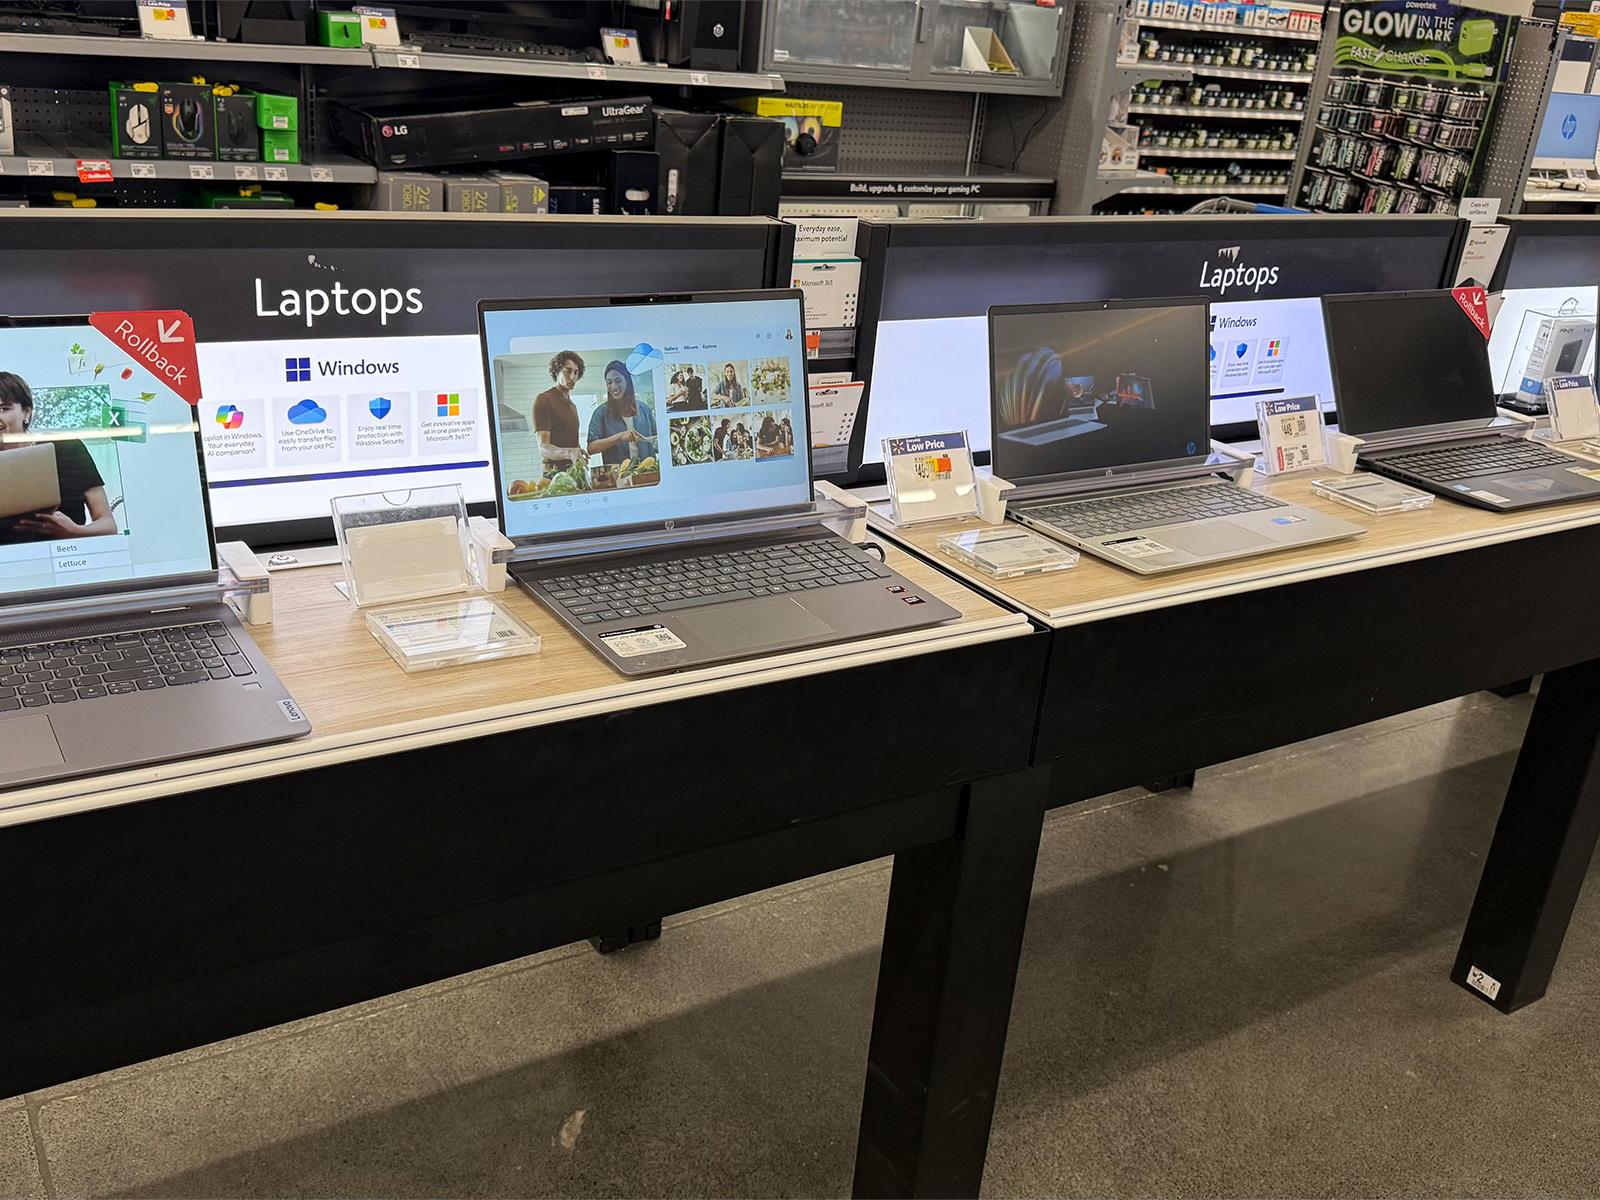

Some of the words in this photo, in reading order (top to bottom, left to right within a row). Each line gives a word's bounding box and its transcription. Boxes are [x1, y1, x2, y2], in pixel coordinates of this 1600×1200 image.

[1405, 1, 1438, 10] powertek
[1343, 8, 1418, 38] GLOW
[1418, 15, 1431, 28] IN
[1434, 16, 1455, 30] THE
[1416, 28, 1452, 42] DARK
[1350, 46, 1374, 60] FAST
[1386, 49, 1430, 66] CHARGE
[602, 104, 646, 118] UltraGear
[394, 126, 408, 135] LG
[850, 184, 868, 192] Build,
[869, 184, 896, 194] upgrade,
[904, 184, 933, 192] customize
[934, 186, 947, 194] your
[948, 186, 970, 194] gaming
[970, 185, 980, 193] PC
[798, 224, 826, 234] Everyday
[821, 234, 848, 244] potential
[1200, 260, 1280, 295] Laptops
[255, 278, 424, 328] Laptops
[1459, 292, 1486, 329] Rollback
[1218, 316, 1258, 329] Windows
[114, 319, 188, 386] Rollback
[318, 359, 400, 377] Windows
[1274, 405, 1286, 414] Low
[1286, 403, 1300, 412] Price
[294, 428, 326, 436] OneDrive
[358, 425, 375, 433] Enjoy
[204, 434, 222, 442] opilot
[278, 437, 296, 445] easily
[298, 436, 322, 444] transfer
[356, 432, 389, 440] protection
[426, 434, 454, 442] Microsoft
[224, 441, 254, 450] everyday
[382, 438, 405, 446] Security
[906, 442, 924, 452] Low
[925, 440, 946, 450] Price
[56, 544, 78, 553] Beets
[58, 558, 87, 568] Lettuce
